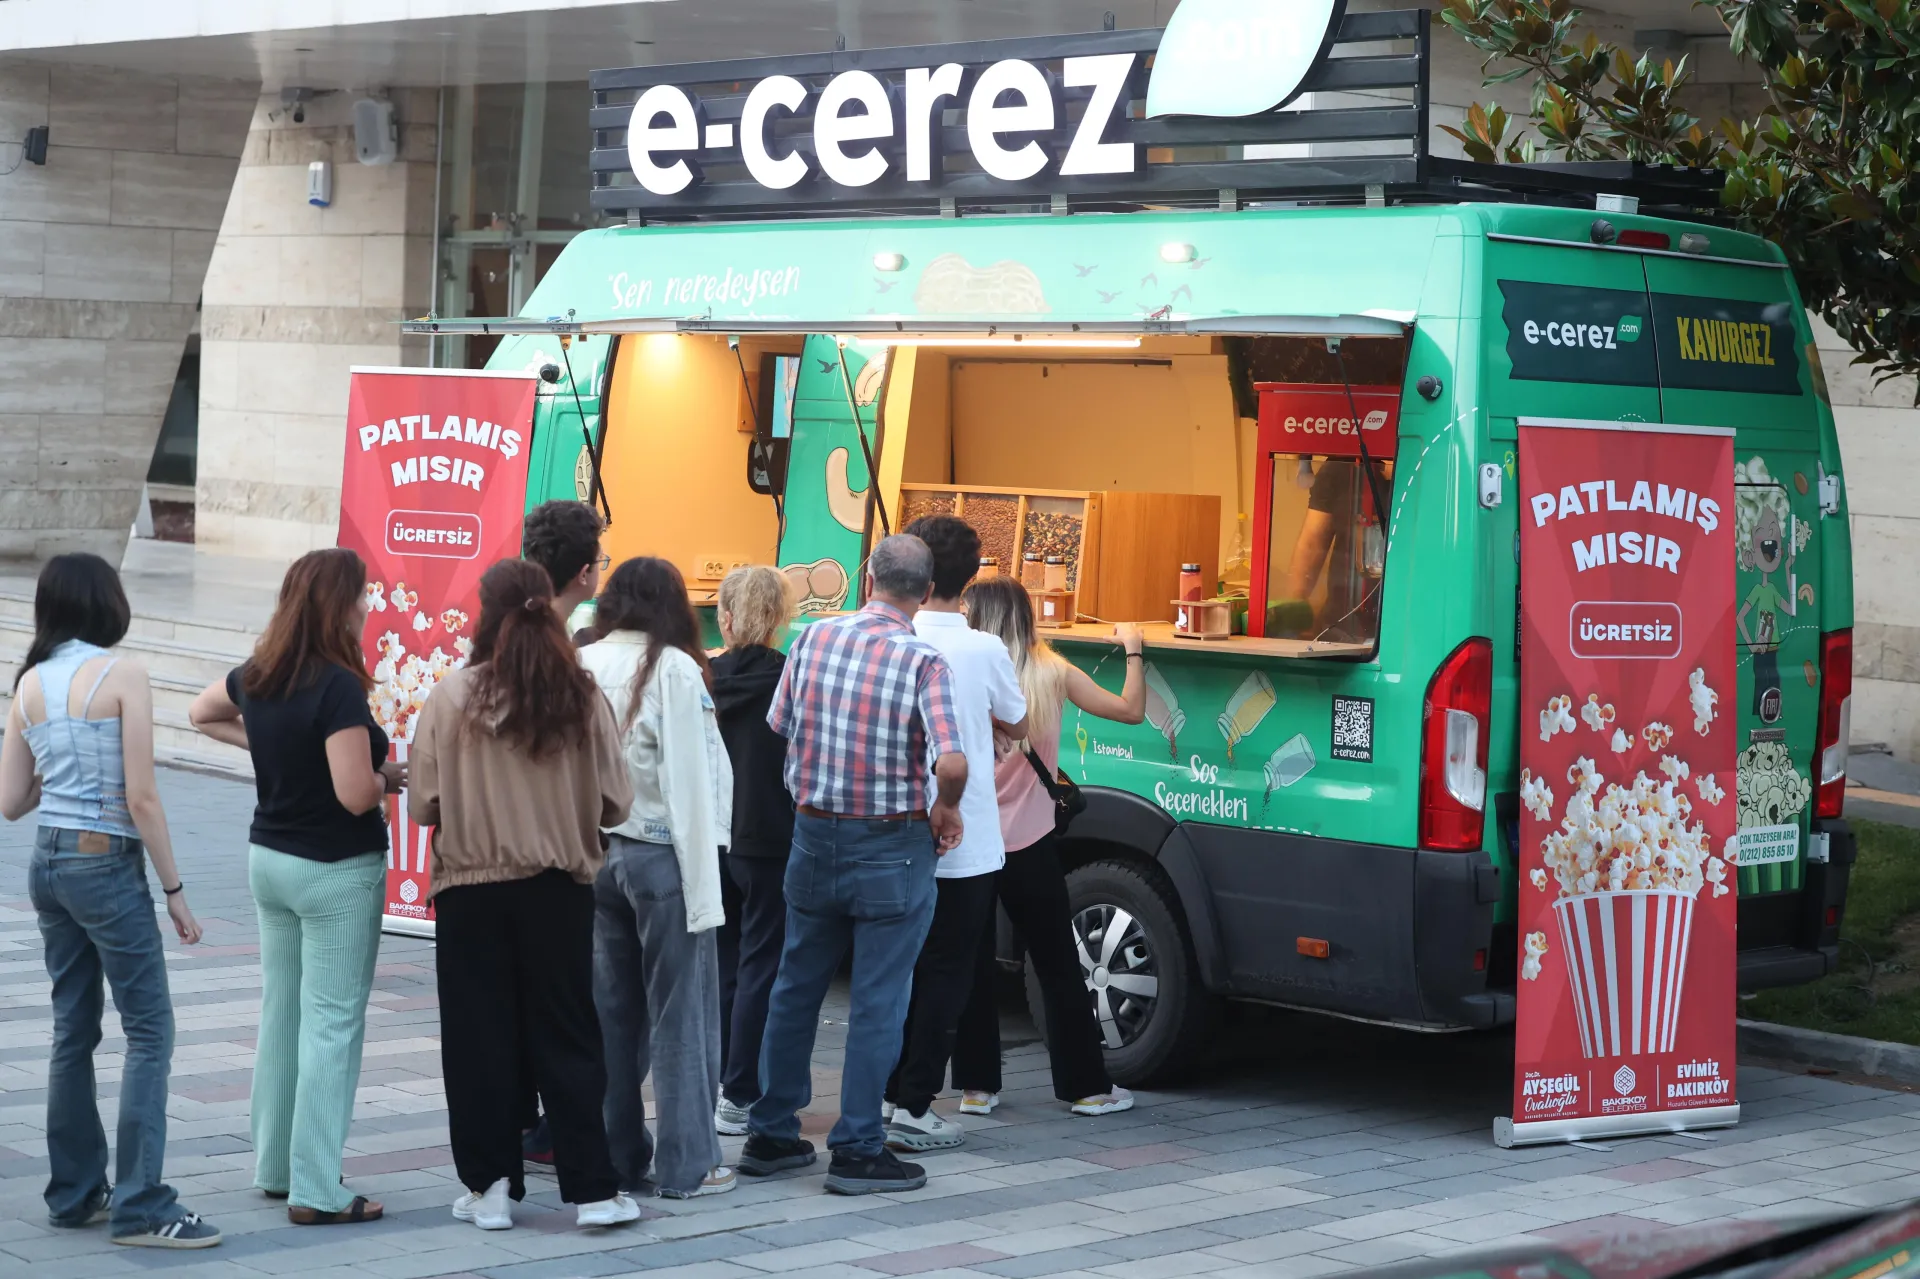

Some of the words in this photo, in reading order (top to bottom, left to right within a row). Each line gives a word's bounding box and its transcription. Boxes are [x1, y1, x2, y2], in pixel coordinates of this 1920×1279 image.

[664, 265, 800, 307] neredeysen
[1676, 316, 1775, 366] KAVURGEZ
[358, 414, 522, 461] PATLAMIŞ
[390, 455, 485, 492] MISIR
[1530, 479, 1721, 536] PATLAMIŞ
[393, 522, 473, 546] ÜCRETSİZ
[1571, 531, 1681, 575] MISIR
[1579, 617, 1673, 642] ÜCRETSİZ
[1092, 737, 1134, 759] İstanbul
[1189, 754, 1219, 785] Sos
[1154, 781, 1248, 821] Seçenekleri
[1783, 829, 1797, 841] ARA!
[1739, 847, 1761, 862] 0(212)
[1762, 846, 1776, 858] 855
[1777, 844, 1786, 857] 85
[1787, 844, 1795, 856] 10
[1677, 1057, 1719, 1079] EVİMİZ
[1522, 1073, 1581, 1097] AYŞEGÜL
[1667, 1076, 1730, 1098] BAKIRKÖY
